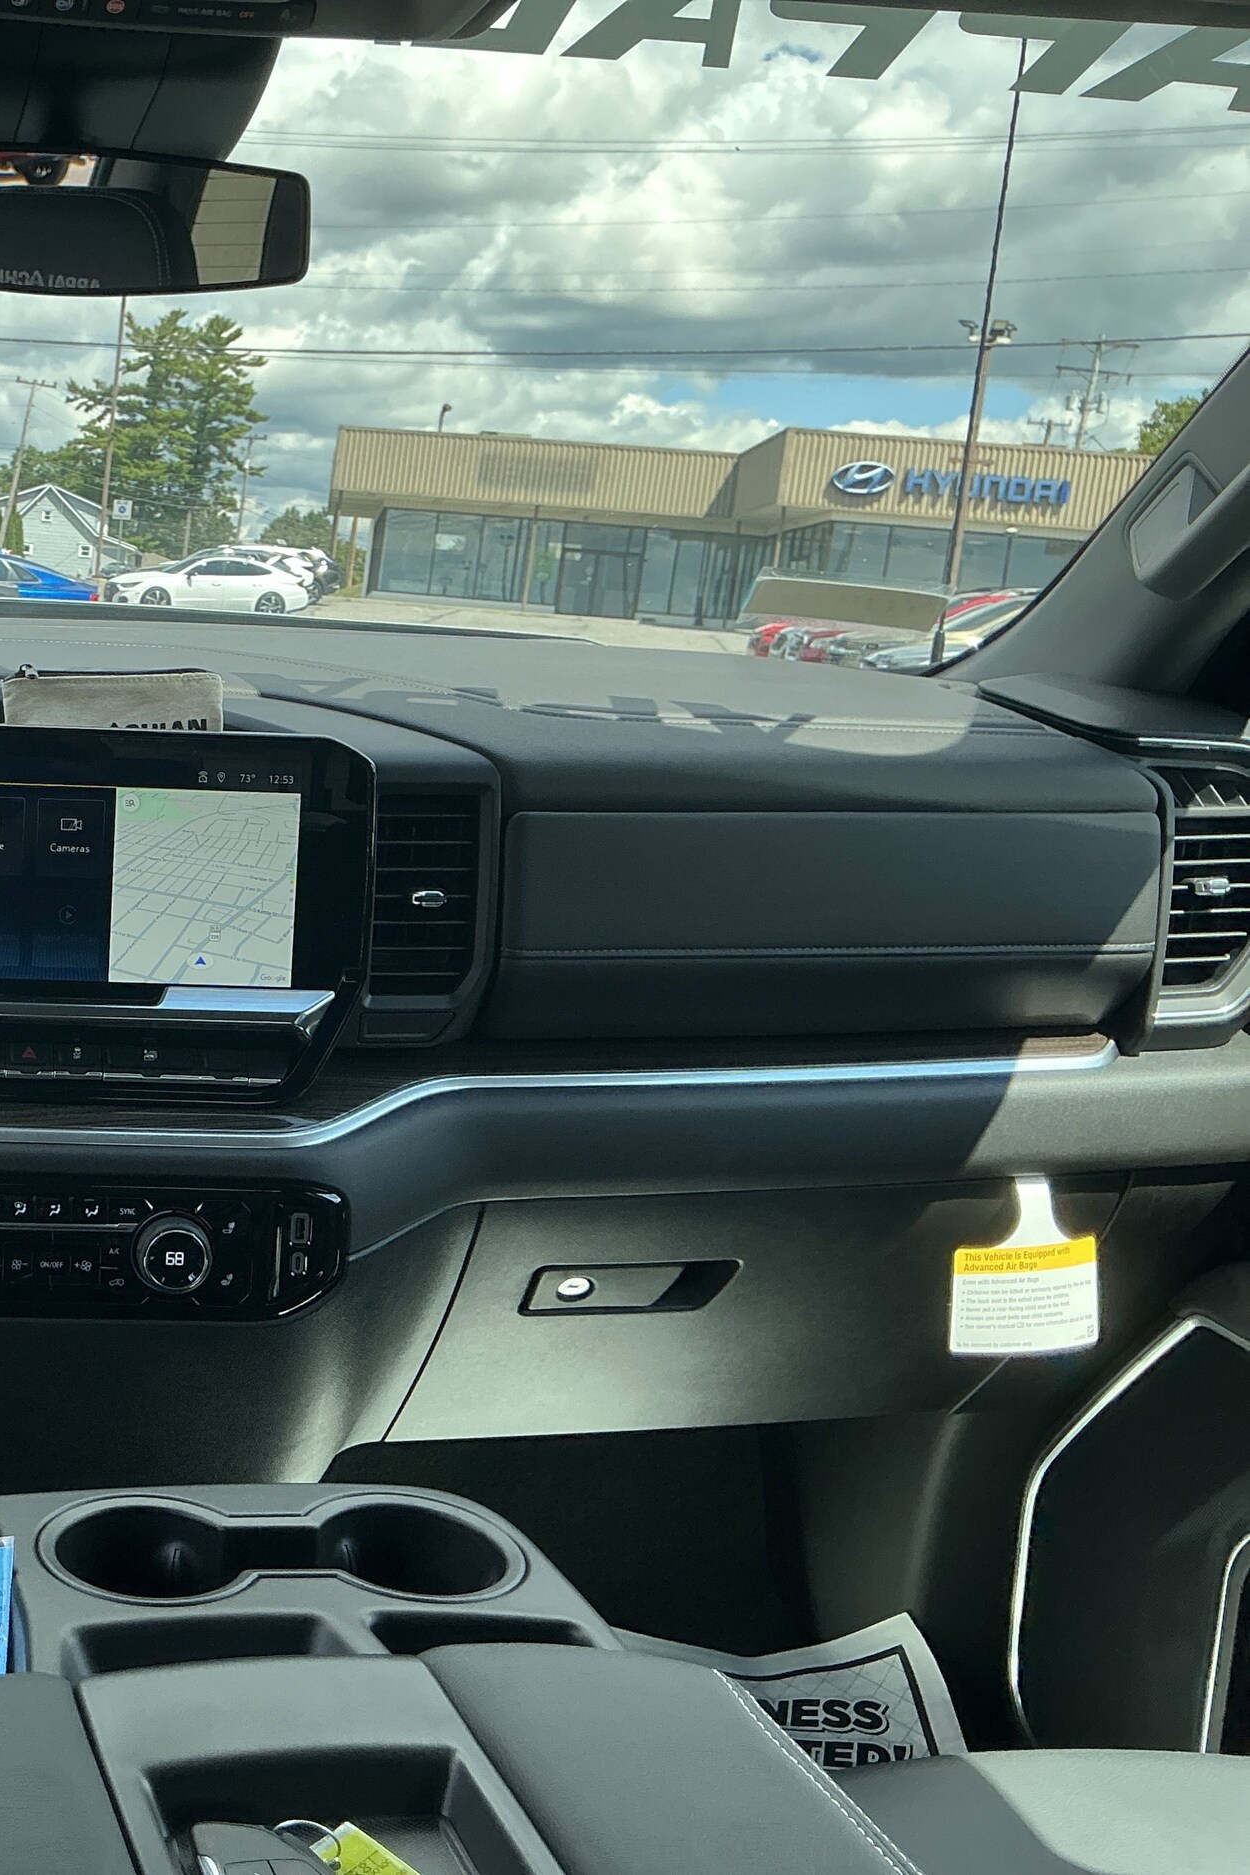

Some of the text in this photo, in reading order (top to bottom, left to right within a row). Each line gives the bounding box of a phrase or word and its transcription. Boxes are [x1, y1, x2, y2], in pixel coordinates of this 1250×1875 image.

[239, 10, 255, 19] OFF
[906, 468, 1071, 506] HYUNDAI
[268, 774, 294, 785] 12:53
[50, 843, 90, 854] Cameras
[260, 973, 286, 983] Google
[119, 1207, 136, 1216] SYNC
[165, 1251, 184, 1266] 68
[964, 1252, 981, 1261] This
[983, 1251, 1012, 1261] Vehicle
[1023, 1248, 1055, 1260] Equipped
[1056, 1246, 1071, 1256] with
[39, 1260, 64, 1268] ON/OFF
[963, 1261, 1037, 1271] Advanced Air Bags
